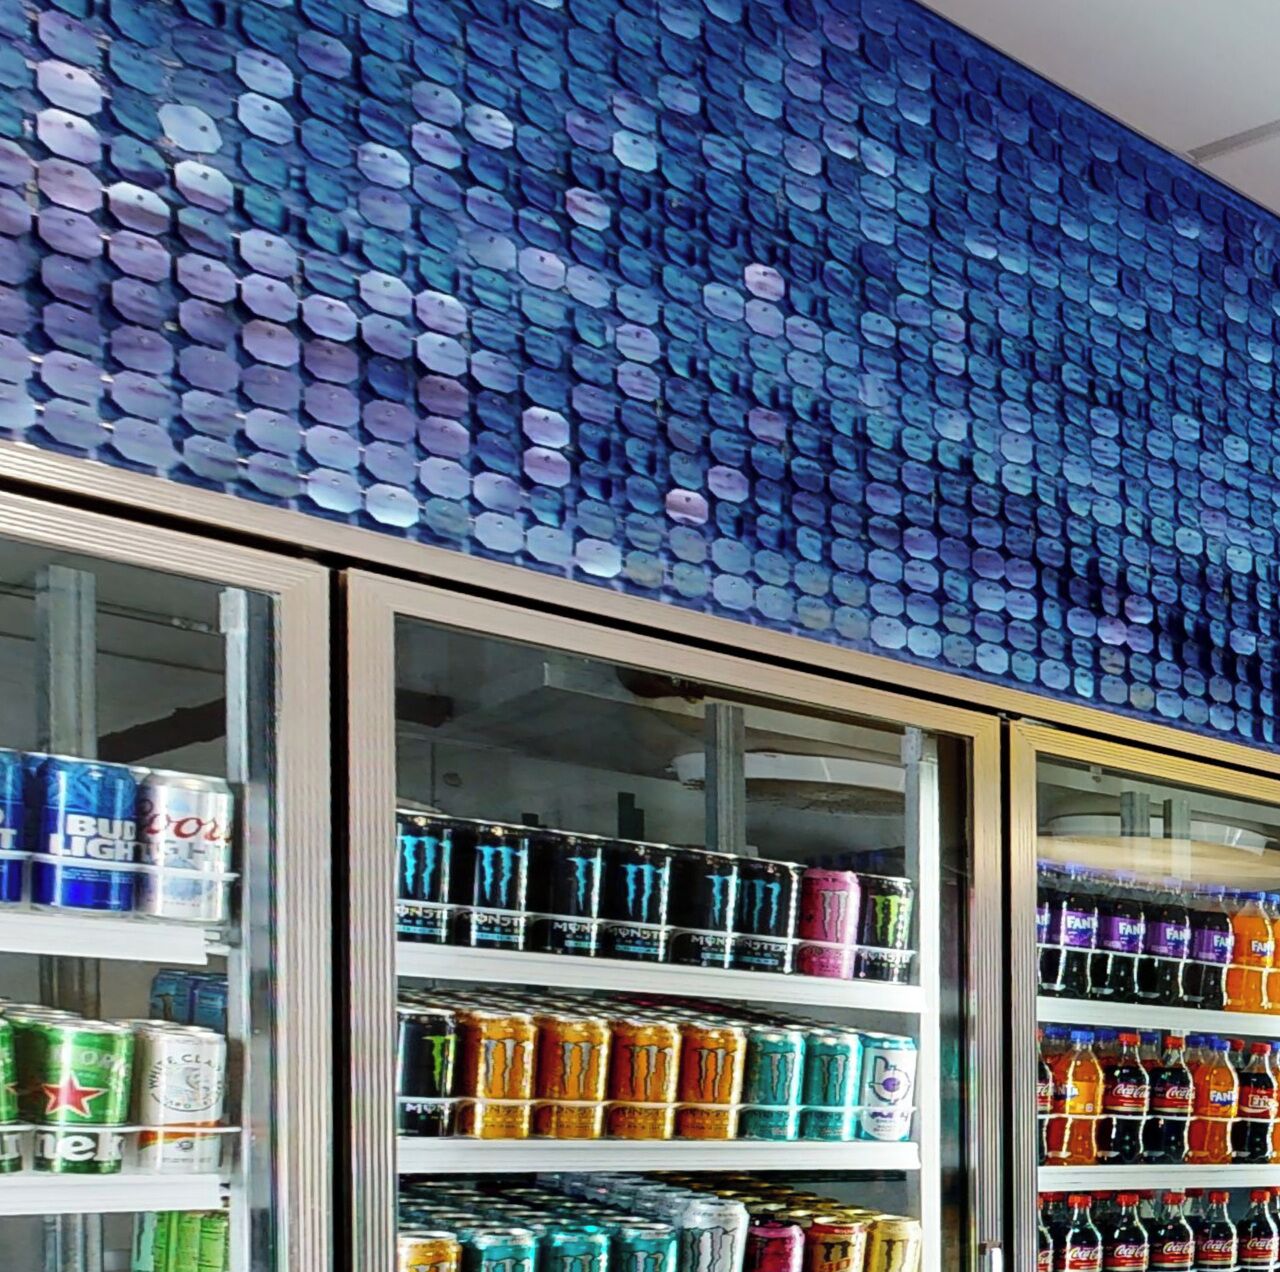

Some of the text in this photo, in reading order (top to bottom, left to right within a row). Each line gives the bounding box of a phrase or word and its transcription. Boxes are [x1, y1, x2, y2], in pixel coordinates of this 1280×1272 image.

[66, 814, 136, 840] BUD
[50, 833, 138, 861] LIGH
[1066, 916, 1098, 930] FANT
